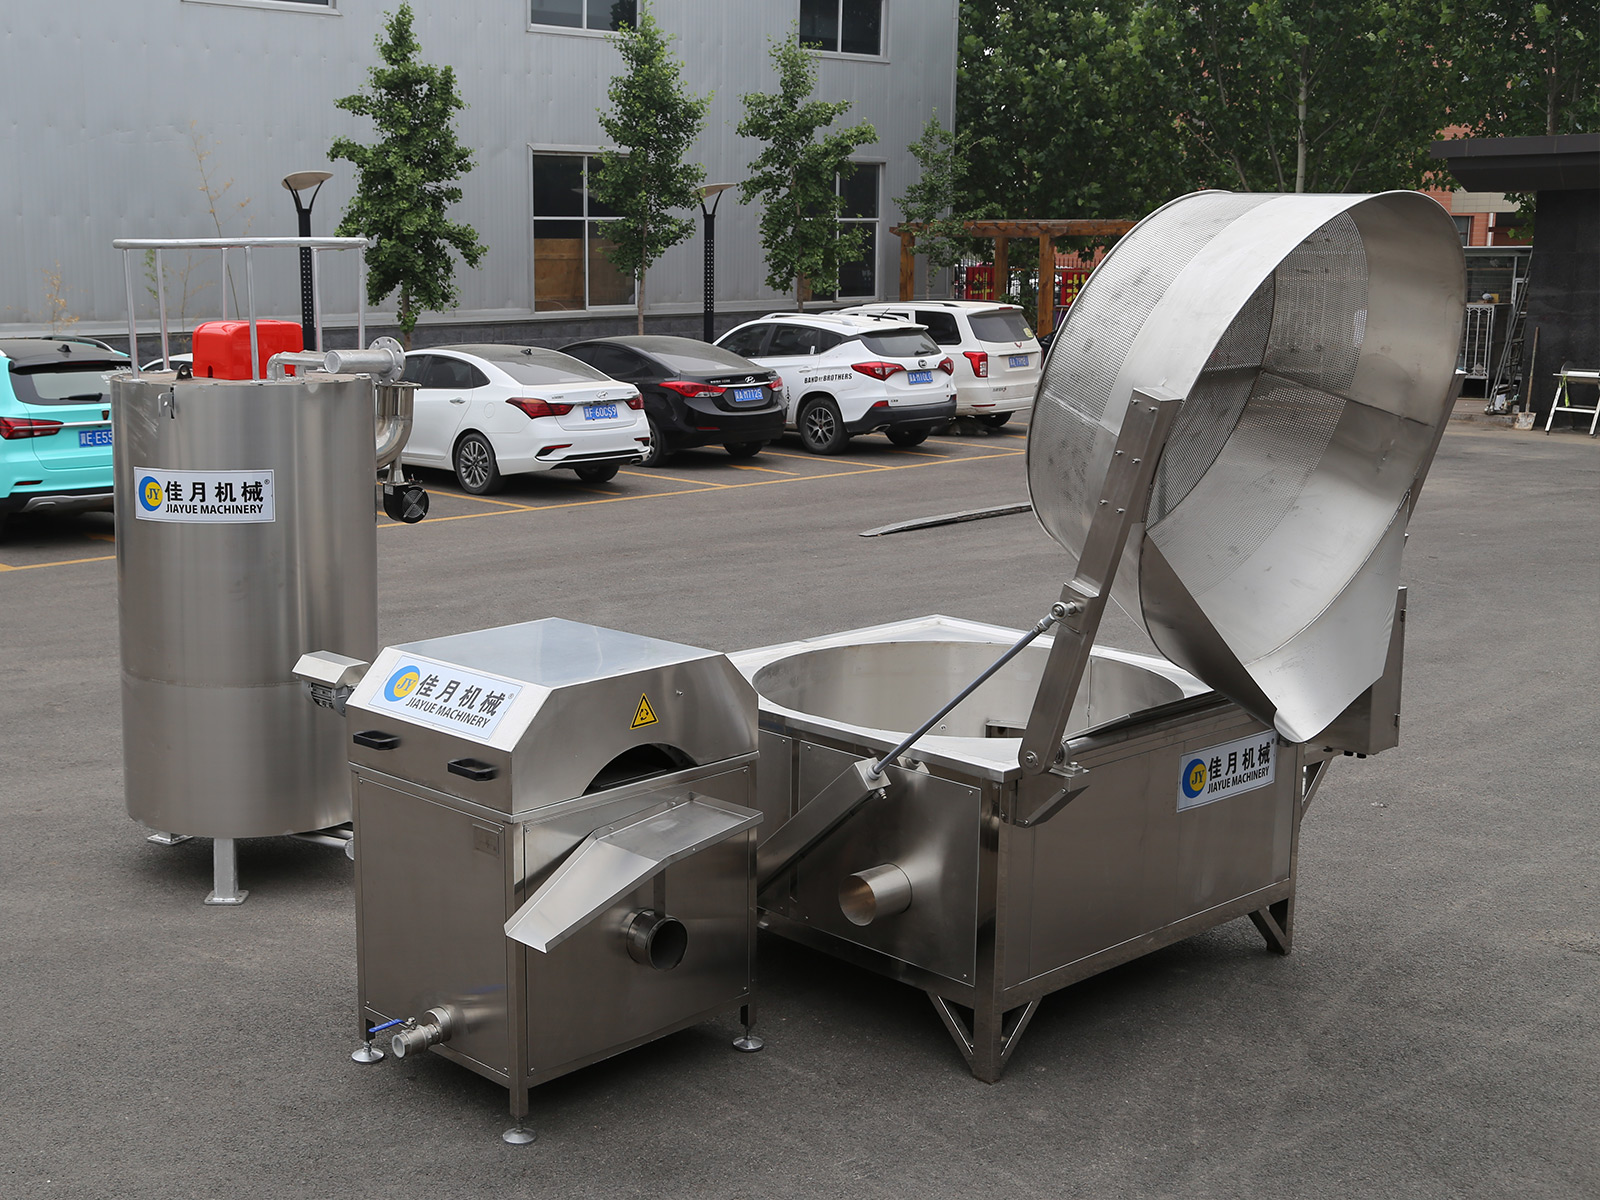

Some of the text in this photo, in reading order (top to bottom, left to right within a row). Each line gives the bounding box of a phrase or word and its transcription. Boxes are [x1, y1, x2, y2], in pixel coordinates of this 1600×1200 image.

[804, 376, 819, 384] BAND
[823, 373, 853, 381] BROTHERS
[147, 488, 160, 500] JY
[165, 481, 264, 503] 佳月机械
[166, 504, 263, 514] JIAYUE MACHINERY
[397, 678, 416, 691] JY
[415, 673, 506, 716] 佳月机械
[405, 697, 491, 728] JIAYUE MACHINERY
[1208, 742, 1271, 781] 佳月机械
[1191, 770, 1205, 785] JY
[1207, 766, 1270, 794] JIAYUE MACHINERY
